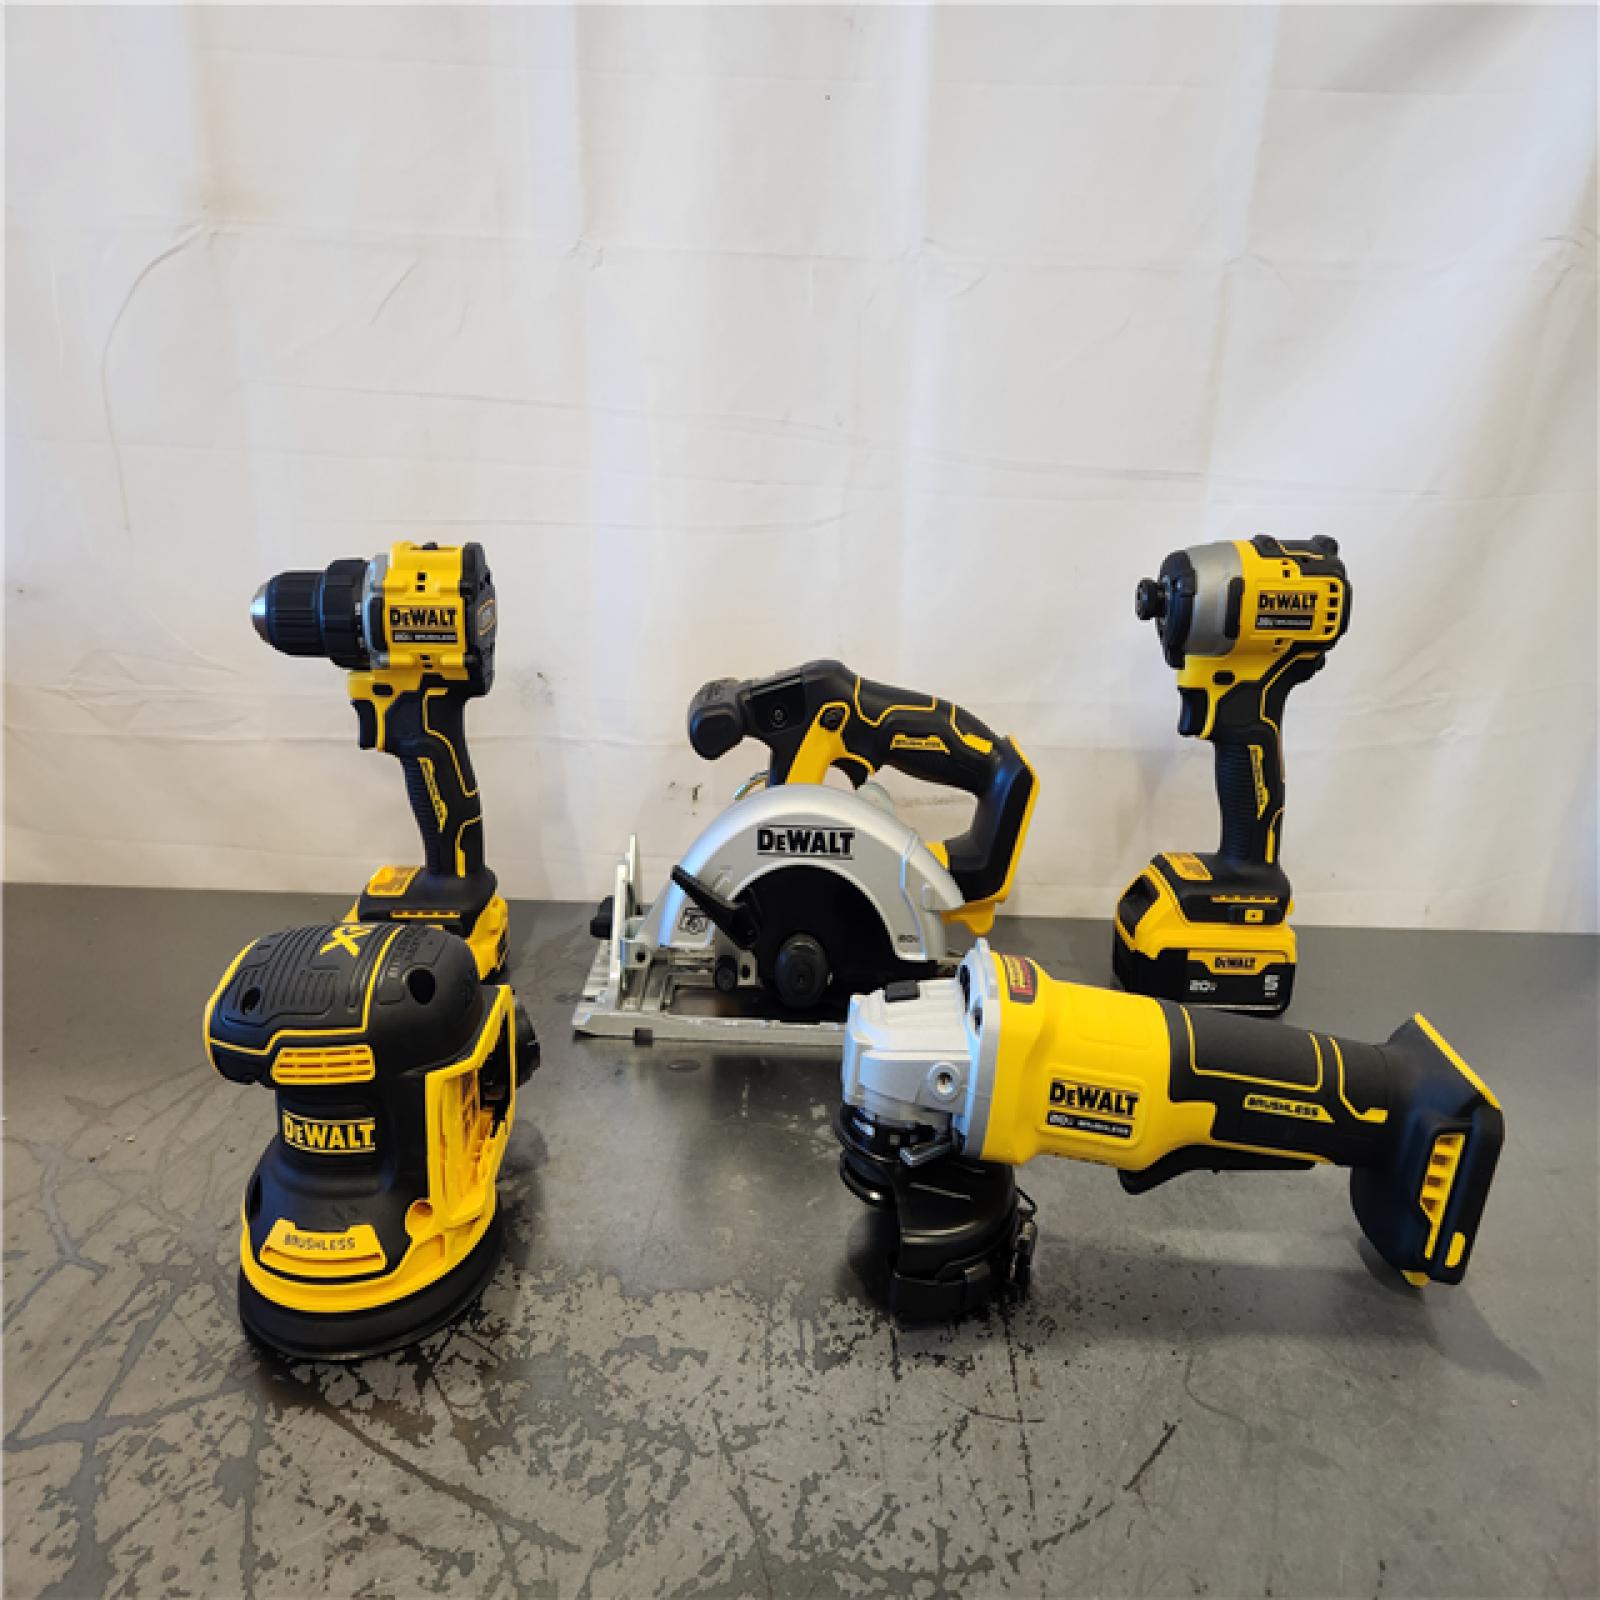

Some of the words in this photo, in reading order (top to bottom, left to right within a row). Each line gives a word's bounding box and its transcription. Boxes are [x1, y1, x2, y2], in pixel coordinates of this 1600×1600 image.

[757, 829, 855, 855] DEWALT
[1049, 1081, 1139, 1116] DEWALT
[283, 1114, 375, 1150] DEWALT
